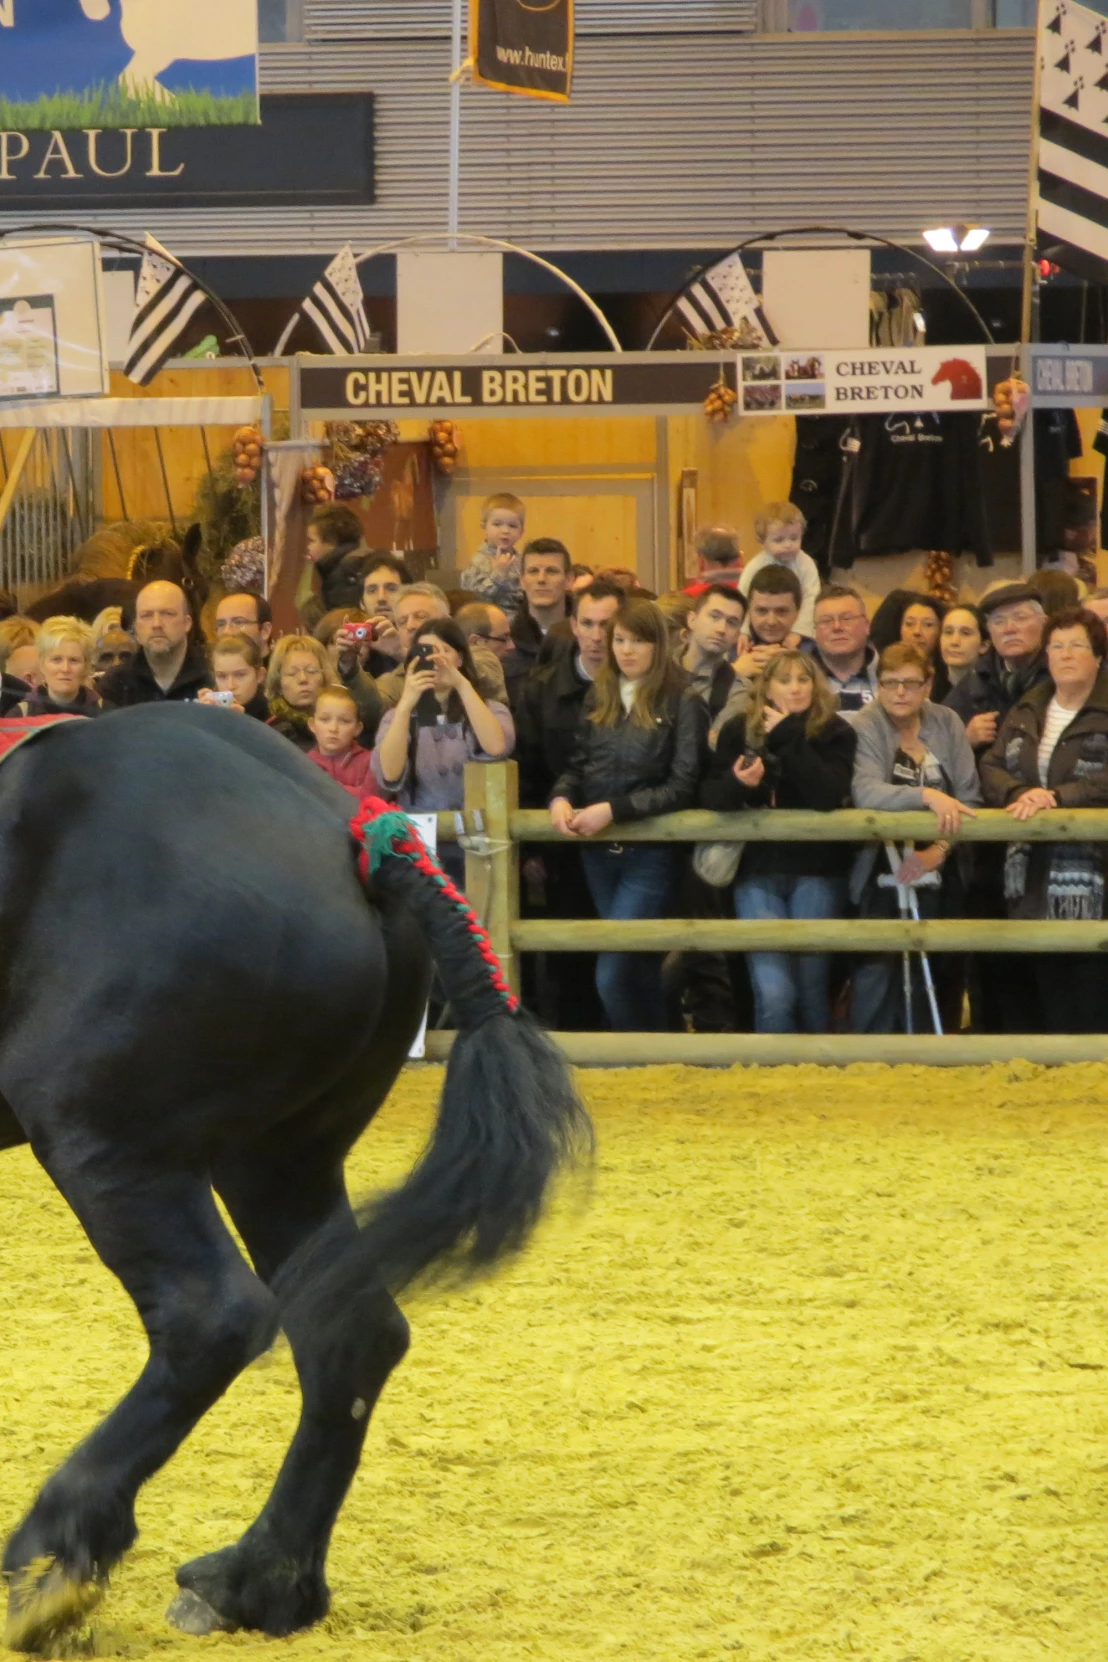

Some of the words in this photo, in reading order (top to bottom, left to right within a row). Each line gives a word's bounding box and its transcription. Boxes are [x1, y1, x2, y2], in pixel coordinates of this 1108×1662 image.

[835, 359, 923, 378] CHEVAL
[345, 370, 472, 406] CHEVAL
[481, 368, 613, 403] BRETON
[835, 384, 925, 402] BRETON
